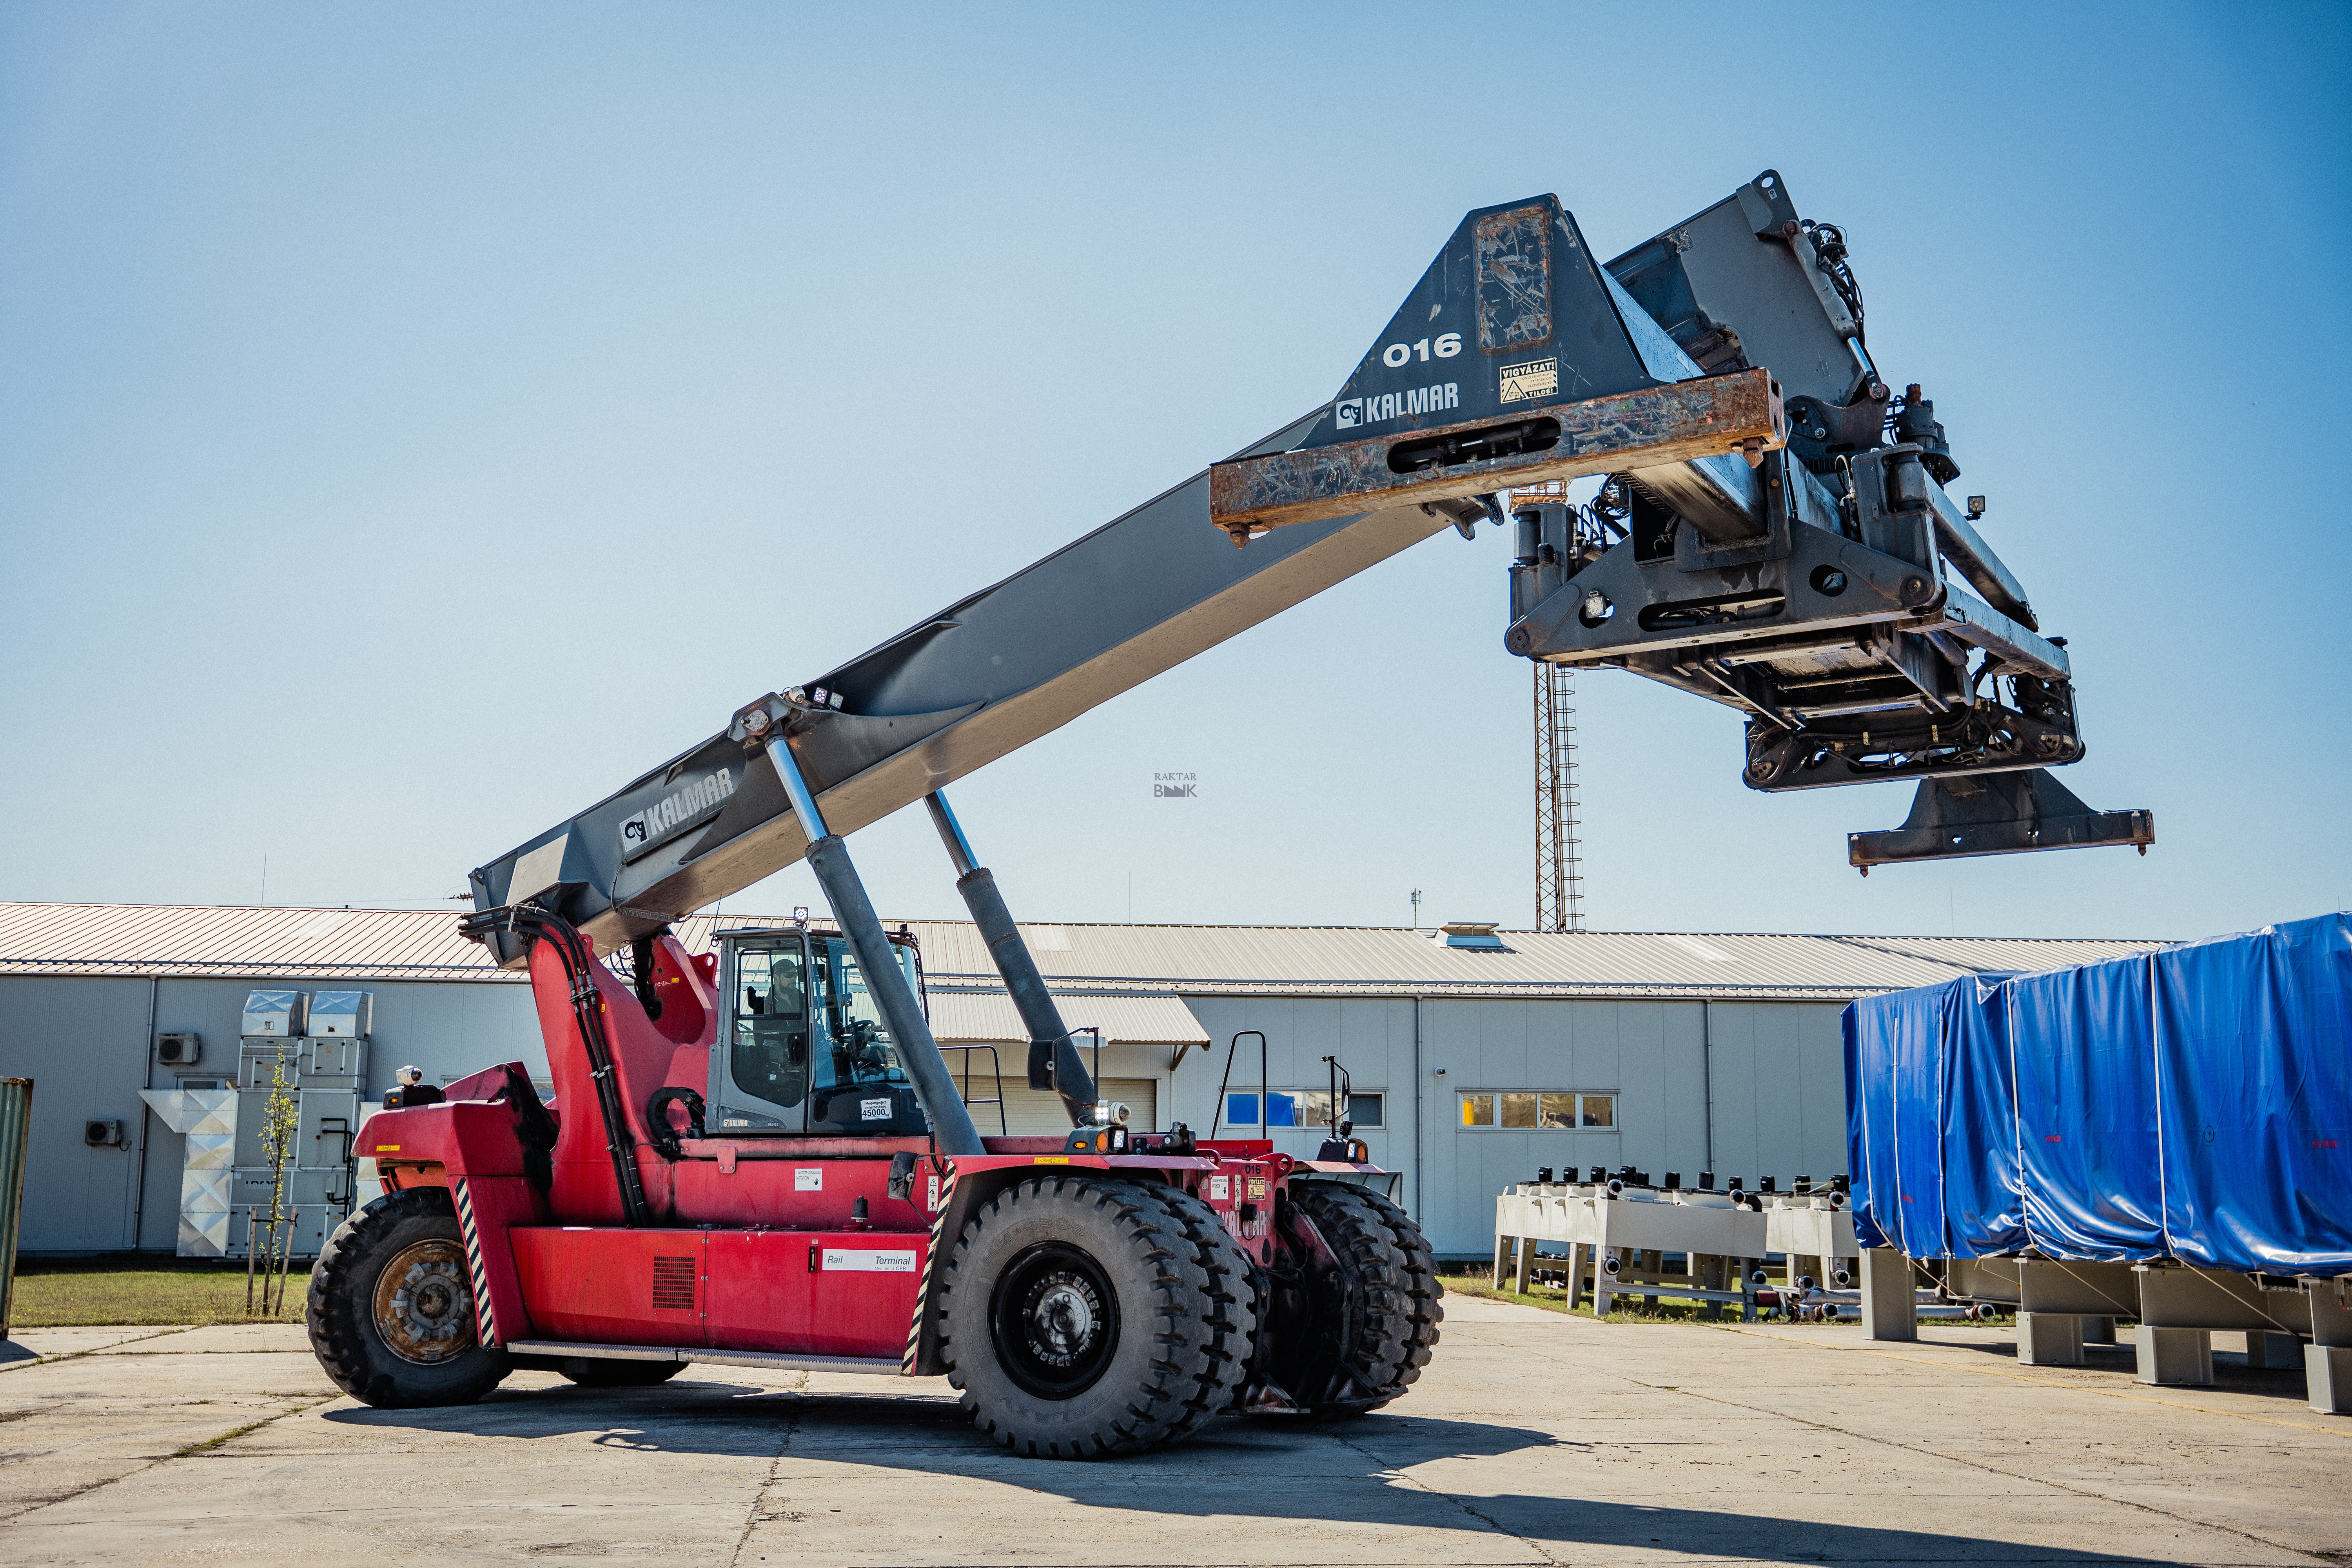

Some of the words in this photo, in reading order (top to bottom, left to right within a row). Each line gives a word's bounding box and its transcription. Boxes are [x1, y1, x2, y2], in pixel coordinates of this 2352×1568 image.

[1383, 332, 1462, 368] 016
[1502, 361, 1555, 378] VIGYÁZAT!
[1366, 383, 1459, 423] KALMAR
[1528, 388, 1553, 397] TILOS!
[647, 768, 734, 836] KALMAR
[862, 1109, 886, 1117] 45000
[1245, 1164, 1261, 1174] 016
[981, 1218, 1085, 1266] HM-450E
[827, 1255, 843, 1264] Rail
[875, 1256, 911, 1265] Terminal
[997, 1394, 1103, 1423] GALAXY
